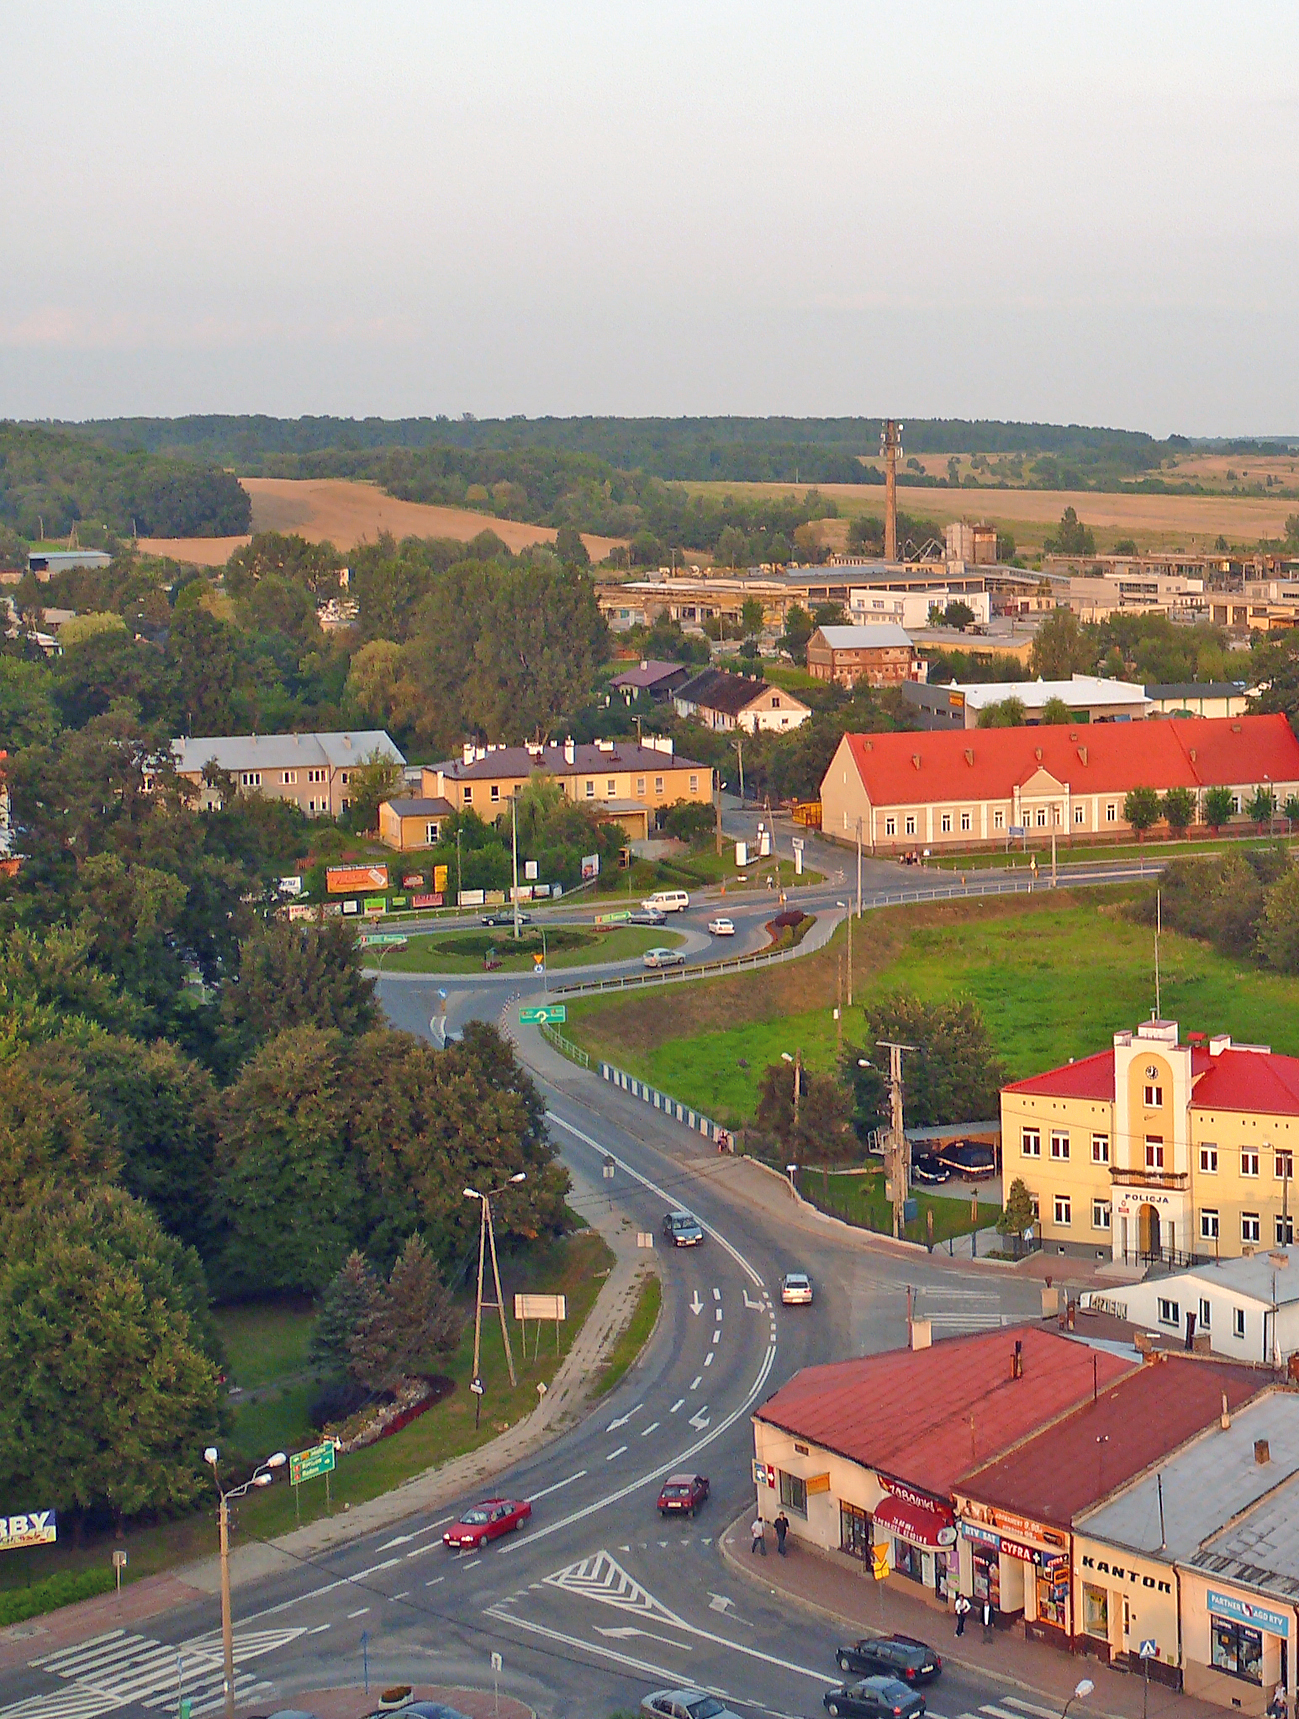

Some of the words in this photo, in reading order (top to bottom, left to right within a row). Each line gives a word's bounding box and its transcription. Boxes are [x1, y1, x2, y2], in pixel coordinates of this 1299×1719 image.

[1125, 1193, 1169, 1204] POLICJA
[1001, 1540, 1031, 1561] CYFRA
[1082, 1555, 1172, 1595] KANTOR
[1211, 1594, 1241, 1612] PARTNER
[1253, 1610, 1269, 1622] AGD
[1268, 1613, 1284, 1626] RTV
